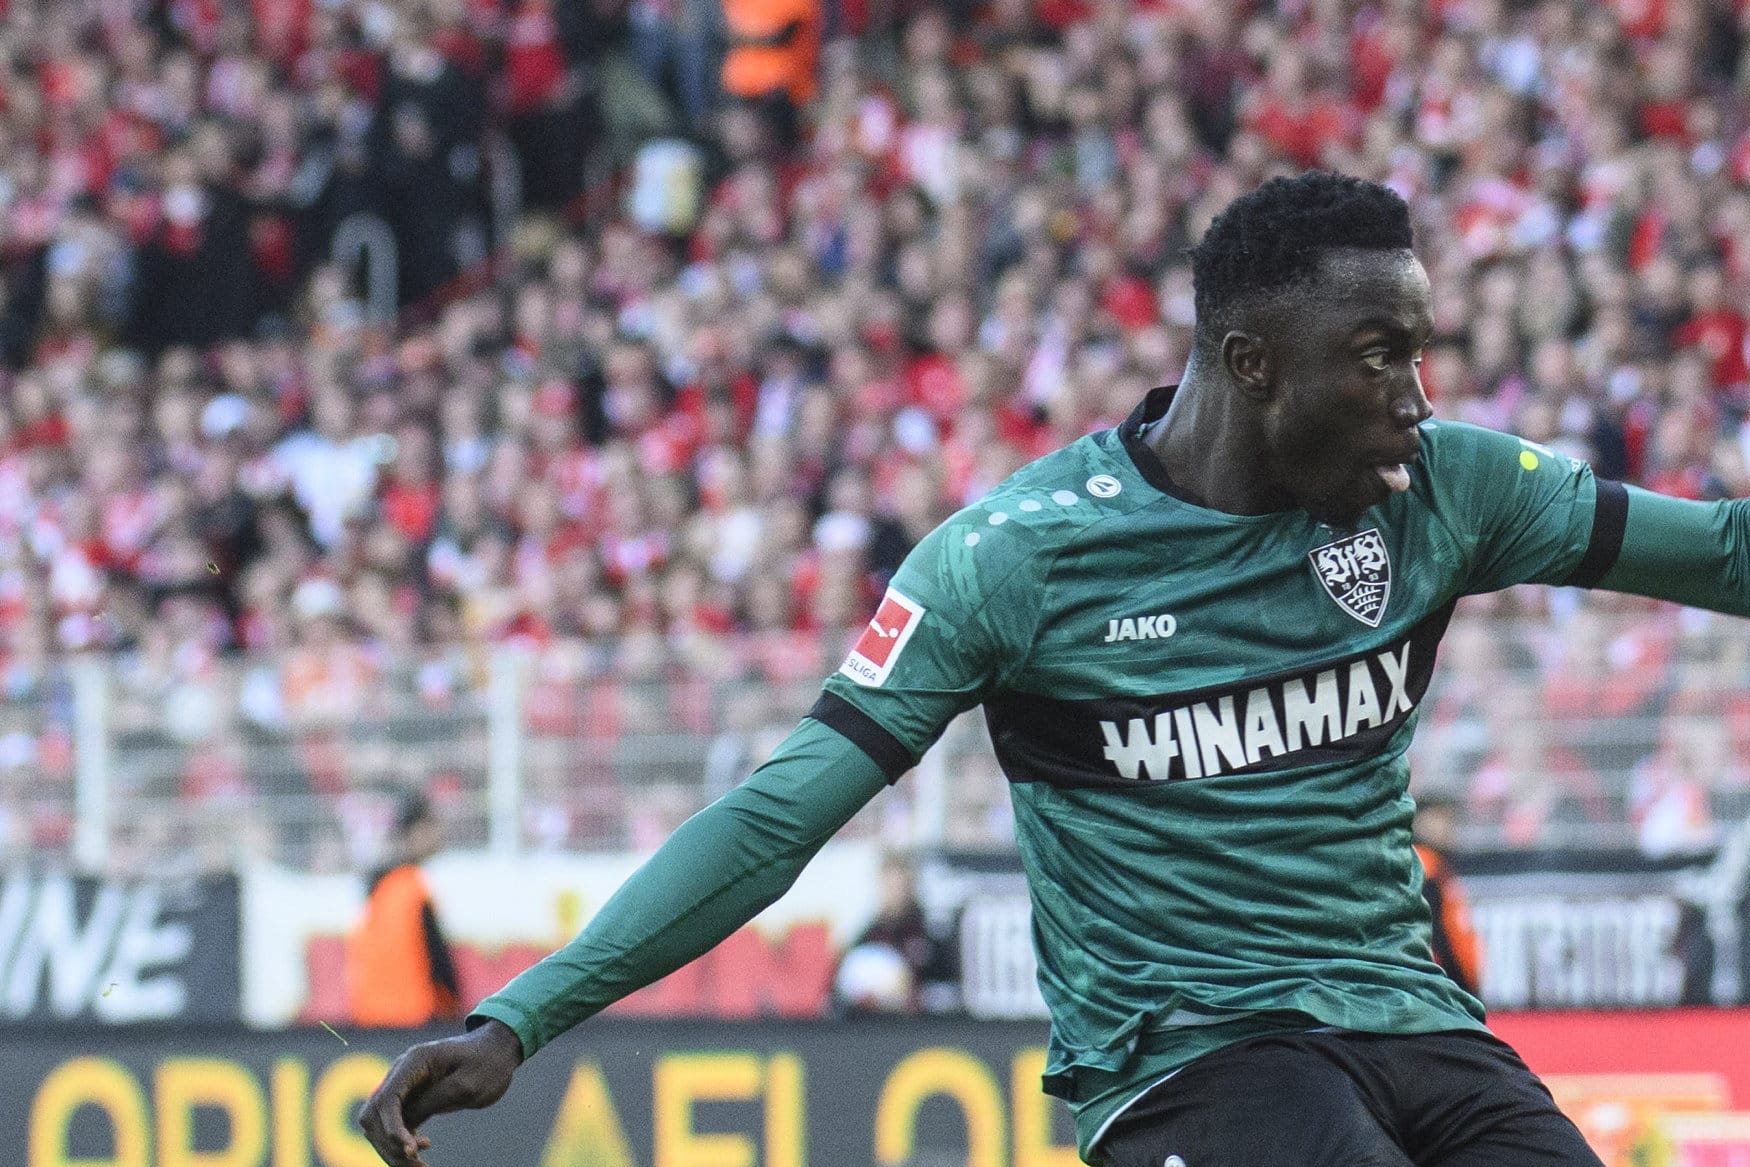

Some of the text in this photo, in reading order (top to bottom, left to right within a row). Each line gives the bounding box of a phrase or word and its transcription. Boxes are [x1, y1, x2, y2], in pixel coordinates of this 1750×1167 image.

[1104, 614, 1177, 642] JAKO
[843, 657, 877, 681] SLIGA
[1100, 640, 1413, 780] WINAMAX
